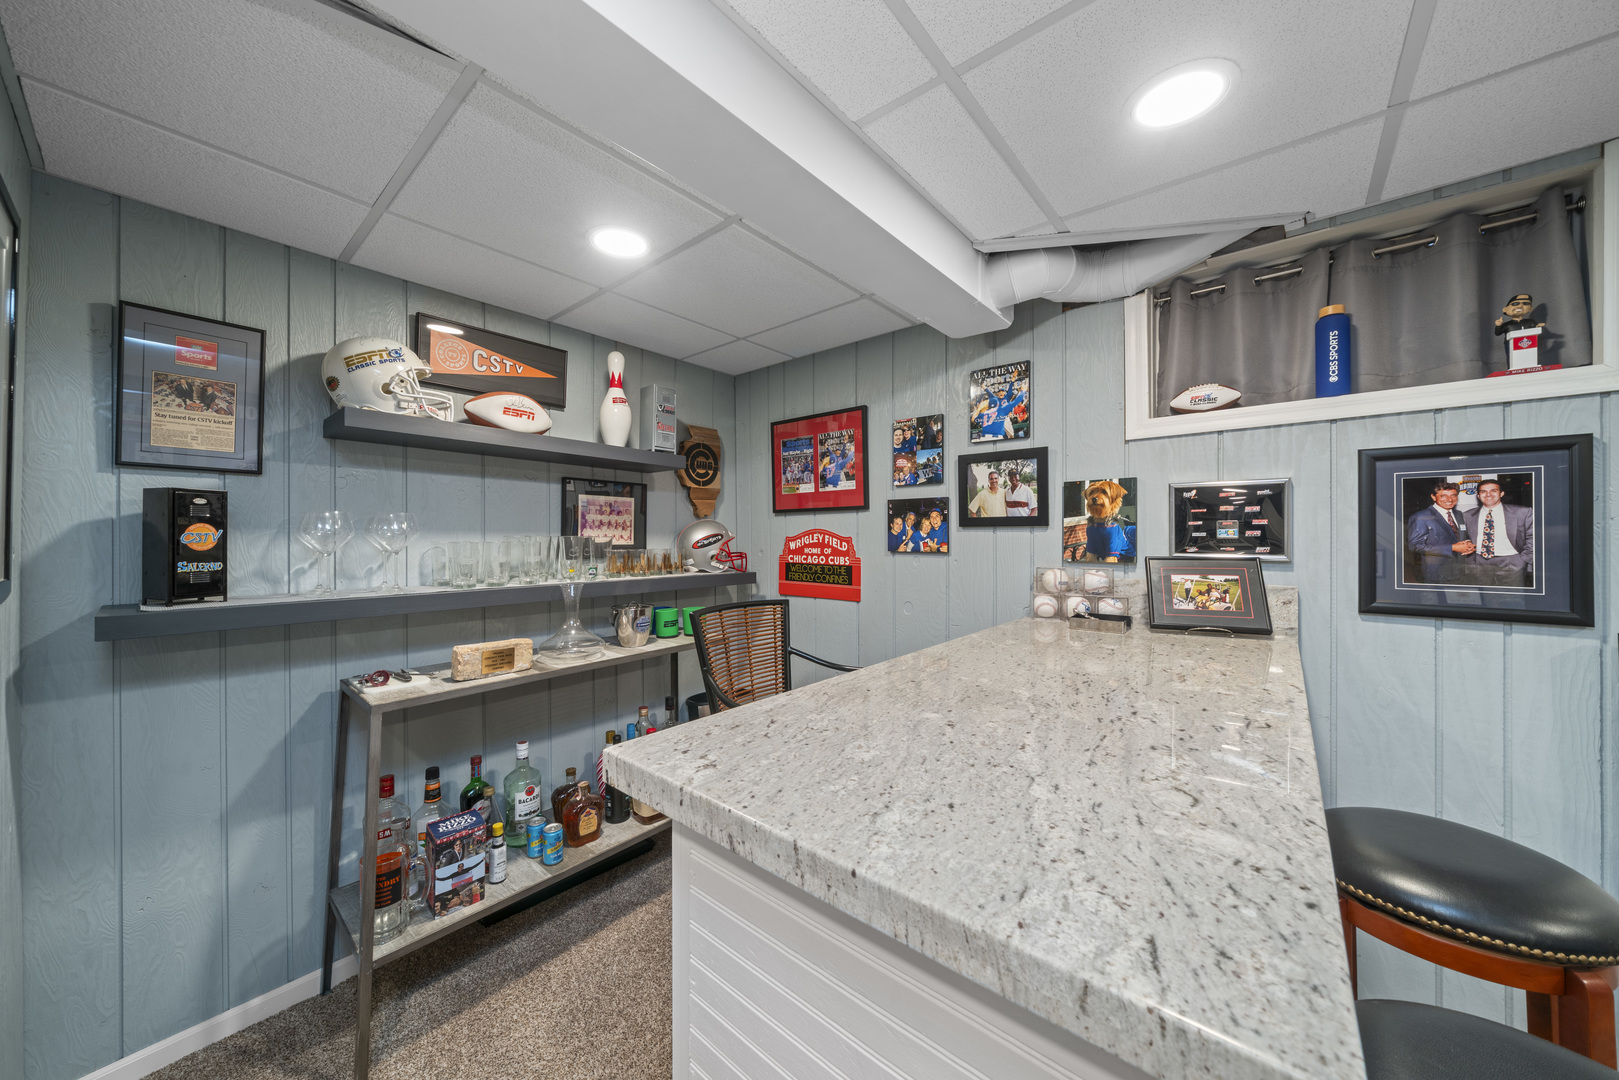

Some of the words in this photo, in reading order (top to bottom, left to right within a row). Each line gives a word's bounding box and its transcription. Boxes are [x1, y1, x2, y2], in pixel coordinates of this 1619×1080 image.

[439, 341, 463, 359] COLLEGE
[1329, 330, 1339, 360] SPORTS
[181, 349, 213, 361] Sports
[343, 349, 391, 368] ESPN
[445, 353, 467, 368] SPORTS
[447, 350, 458, 358] TV
[472, 349, 524, 374] CSTV
[347, 360, 377, 373] CLASSIC
[378, 357, 406, 365] SPORTS
[991, 368, 1007, 378] THE
[1007, 363, 1027, 373] WAY
[1329, 360, 1338, 376] CBS
[1190, 396, 1218, 404] CLASSIC
[168, 413, 187, 421] tuned
[213, 418, 233, 426] kickoff
[502, 406, 536, 421] ESPN
[180, 529, 224, 544] CSTV
[789, 533, 824, 550] WRIGLEY
[824, 534, 848, 551] FIELD
[177, 561, 224, 573] SALERNO
[788, 554, 826, 564] CHICAGO
[828, 556, 850, 565] CUBS
[790, 563, 822, 573] WELCOME
[823, 565, 833, 574] TO
[833, 566, 847, 575] THE
[788, 571, 815, 582] FRIENDLY
[815, 573, 849, 584] CONFINES
[663, 618, 679, 628] ESP
[438, 813, 470, 829] MIKE
[438, 816, 477, 832] RIZZO
